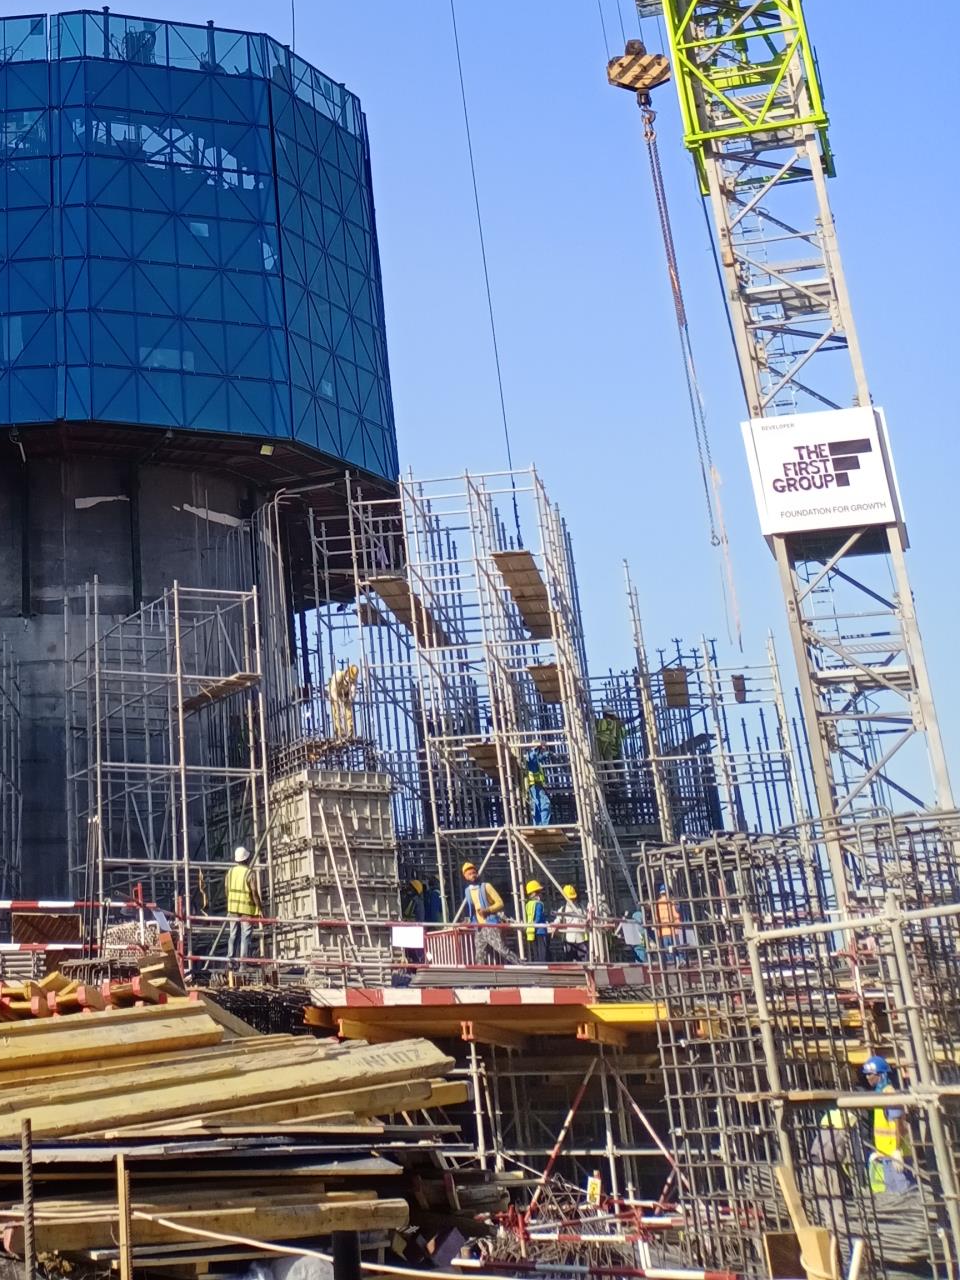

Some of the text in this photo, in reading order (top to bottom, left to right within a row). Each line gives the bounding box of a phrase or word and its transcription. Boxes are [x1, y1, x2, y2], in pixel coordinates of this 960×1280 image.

[793, 443, 829, 461] THE
[782, 459, 830, 477] FIRST
[772, 473, 835, 493] GROUP
[780, 501, 887, 518] FOUNDATION FOR GROWTH
